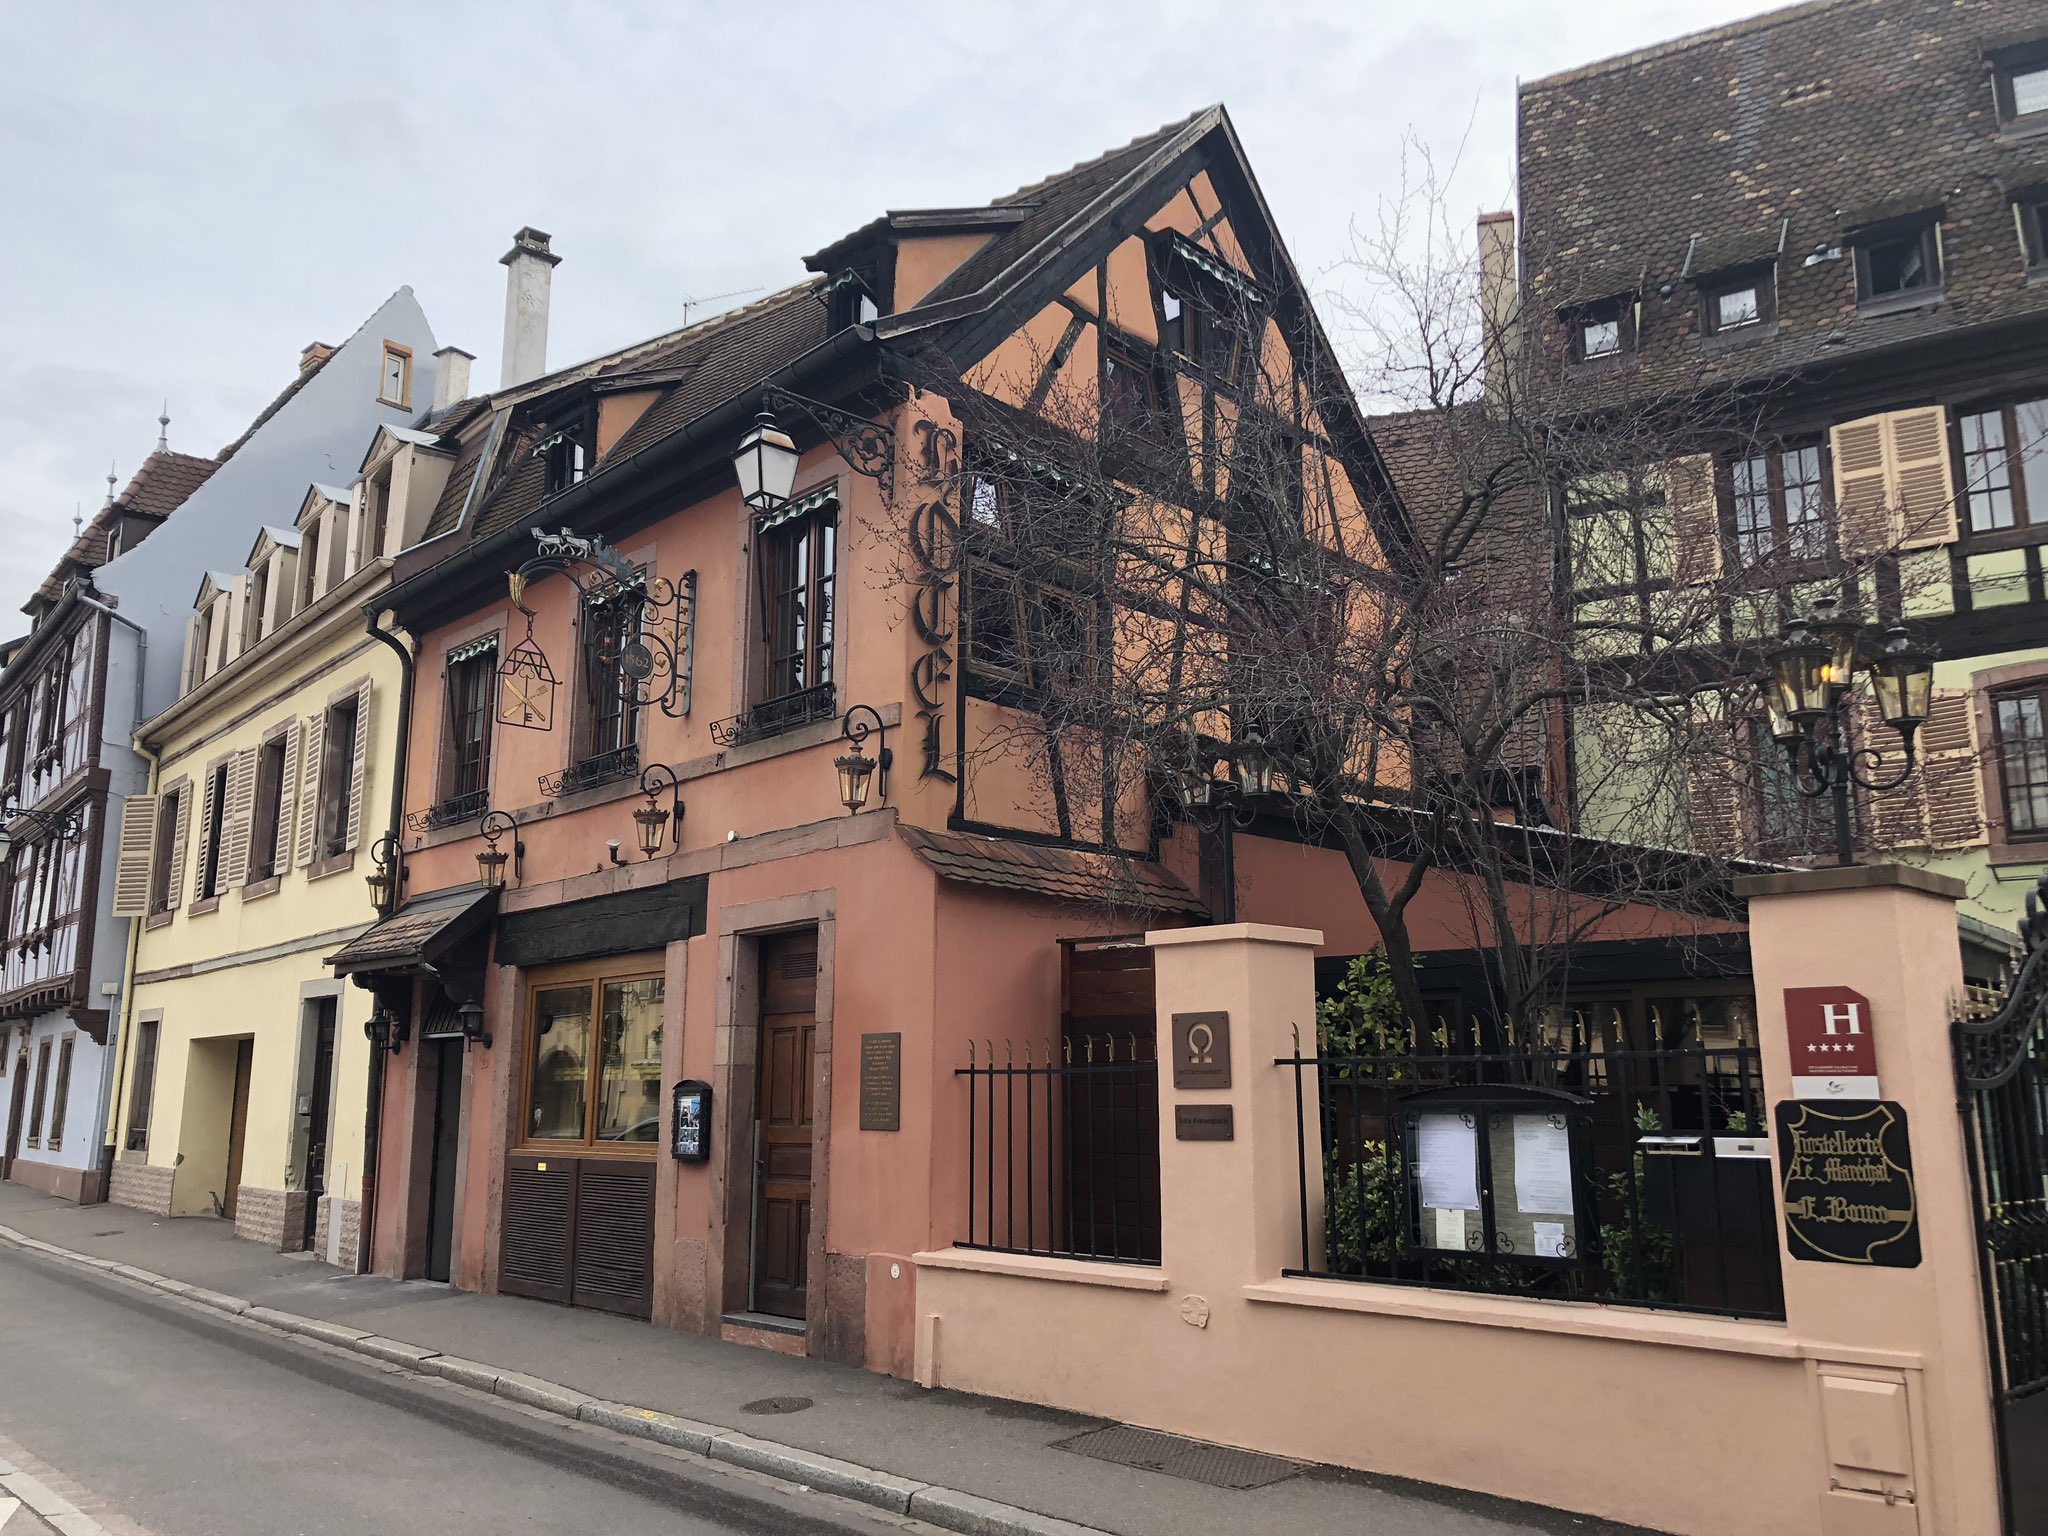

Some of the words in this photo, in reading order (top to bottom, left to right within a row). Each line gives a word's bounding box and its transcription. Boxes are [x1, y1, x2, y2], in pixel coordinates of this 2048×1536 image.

[625, 654, 649, 668] 1562
[1819, 1002, 1864, 1035] H
[1792, 1130, 1883, 1155] Hostellerie
[1789, 1156, 1814, 1180] Le
